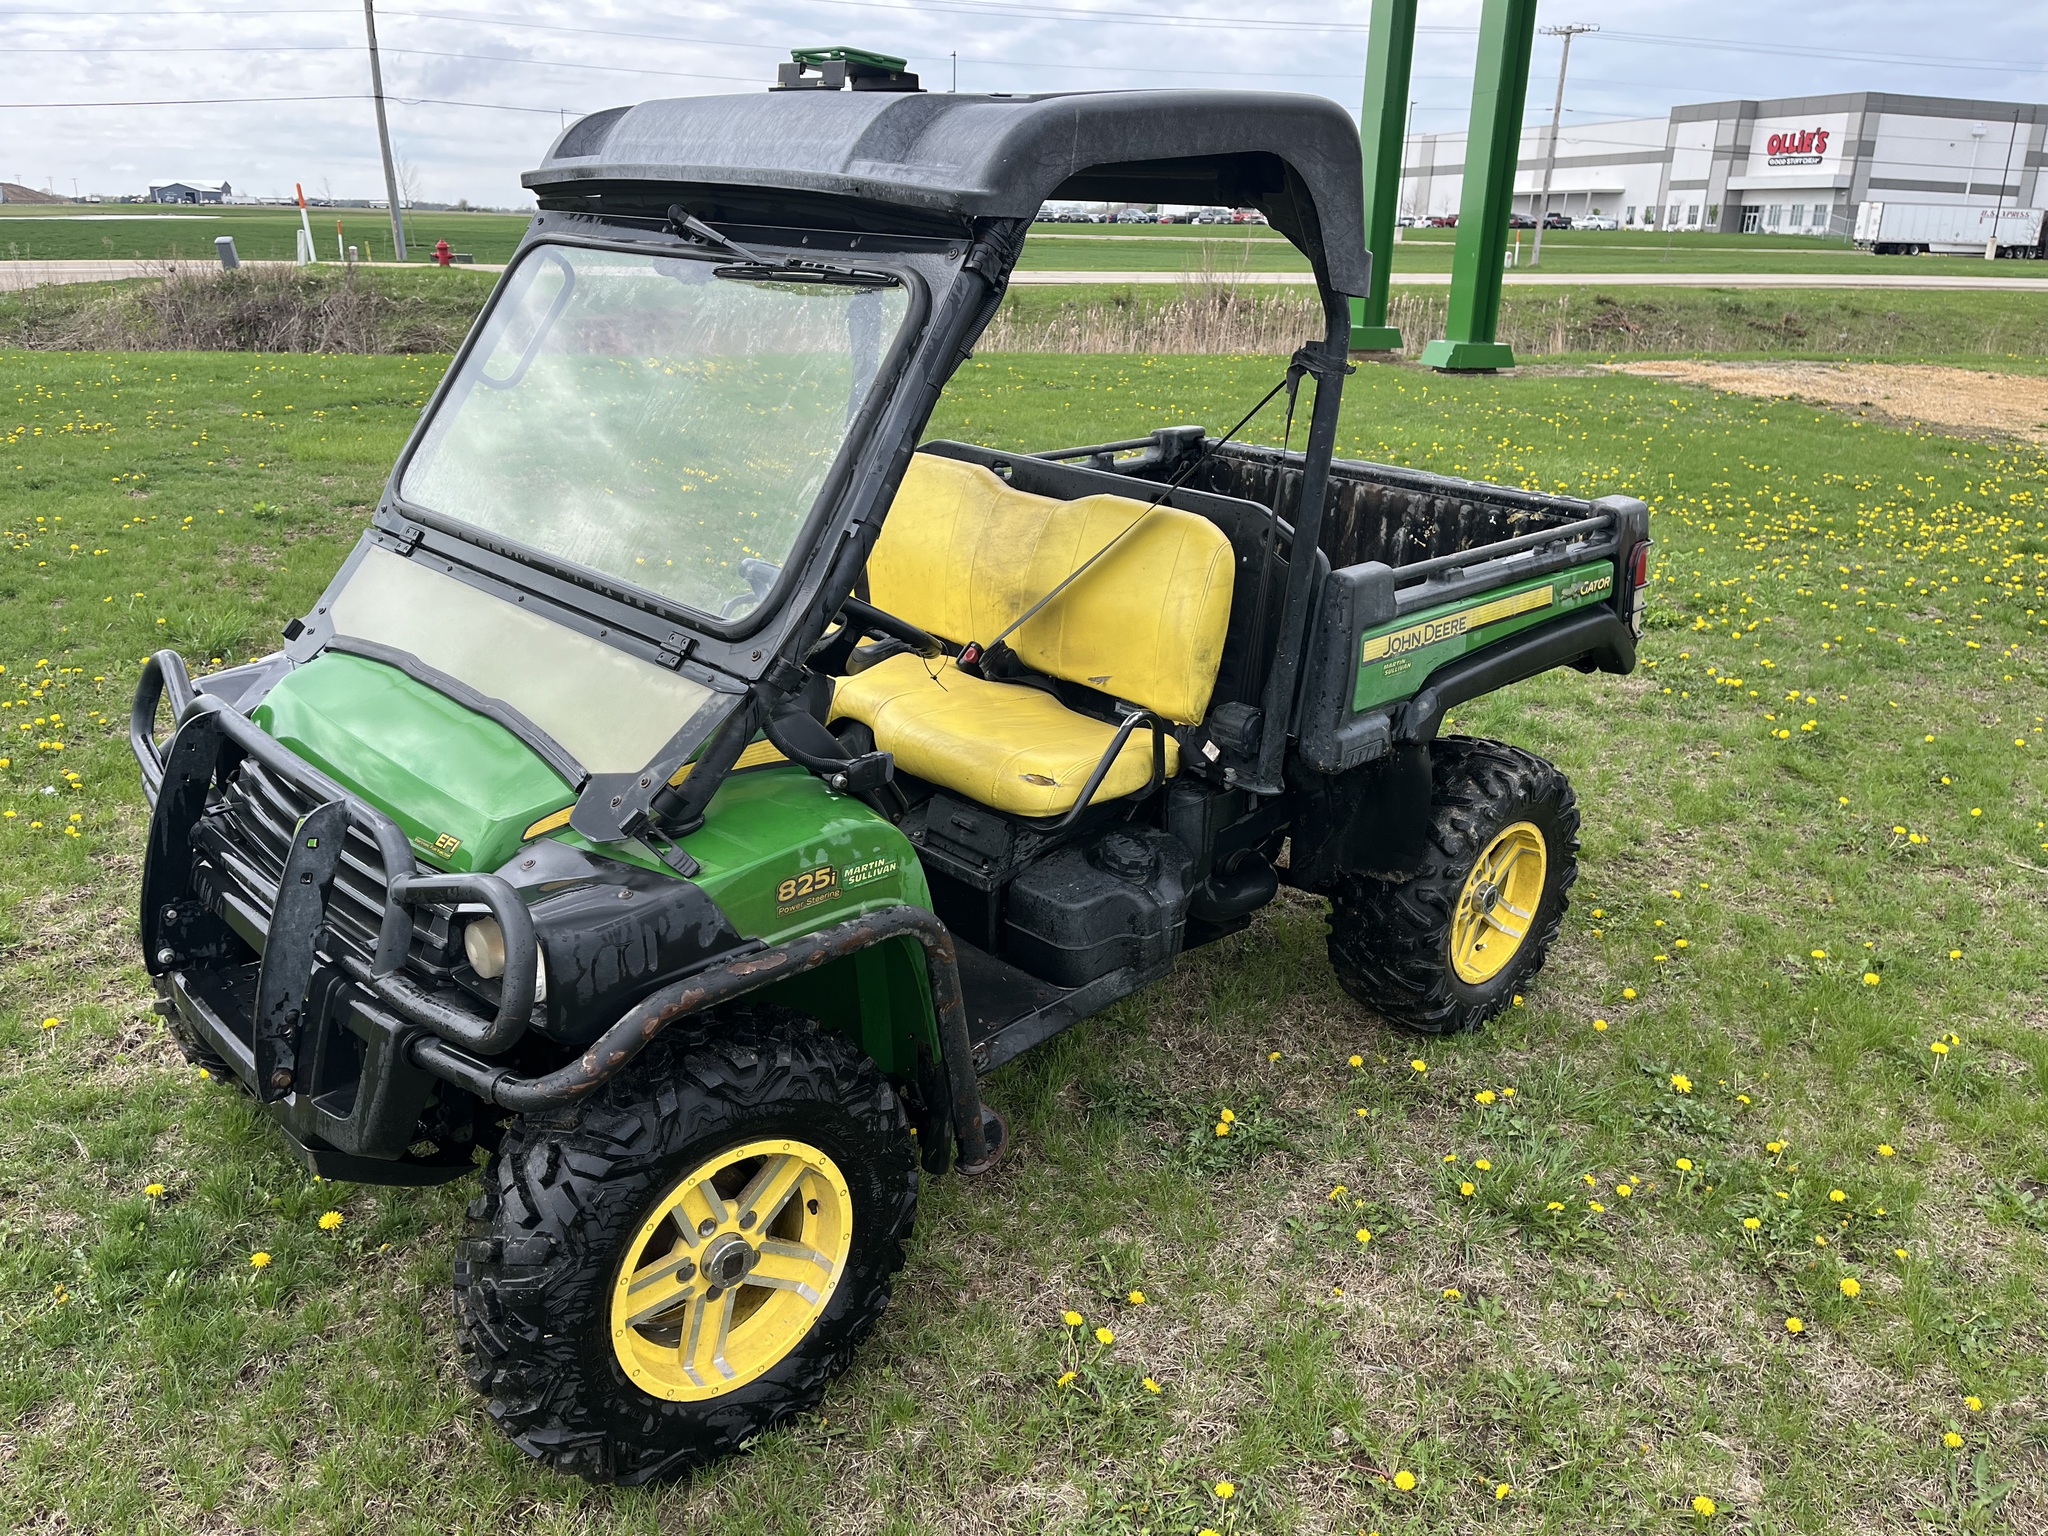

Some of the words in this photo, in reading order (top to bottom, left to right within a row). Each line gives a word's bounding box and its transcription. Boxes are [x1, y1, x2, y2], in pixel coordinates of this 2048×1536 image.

[1580, 576, 1611, 596] GATOR
[1383, 631, 1421, 656] JOHN
[1424, 616, 1467, 643] DEERE
[1383, 658, 1407, 670] MARTIN
[1384, 662, 1412, 676] SULLIVAN
[435, 833, 461, 854] EFI
[844, 858, 886, 878] MARTIN
[848, 862, 897, 885] SULLIVAN
[778, 867, 836, 902] 825i
[778, 901, 804, 916] Power
[806, 889, 840, 906] Steering
